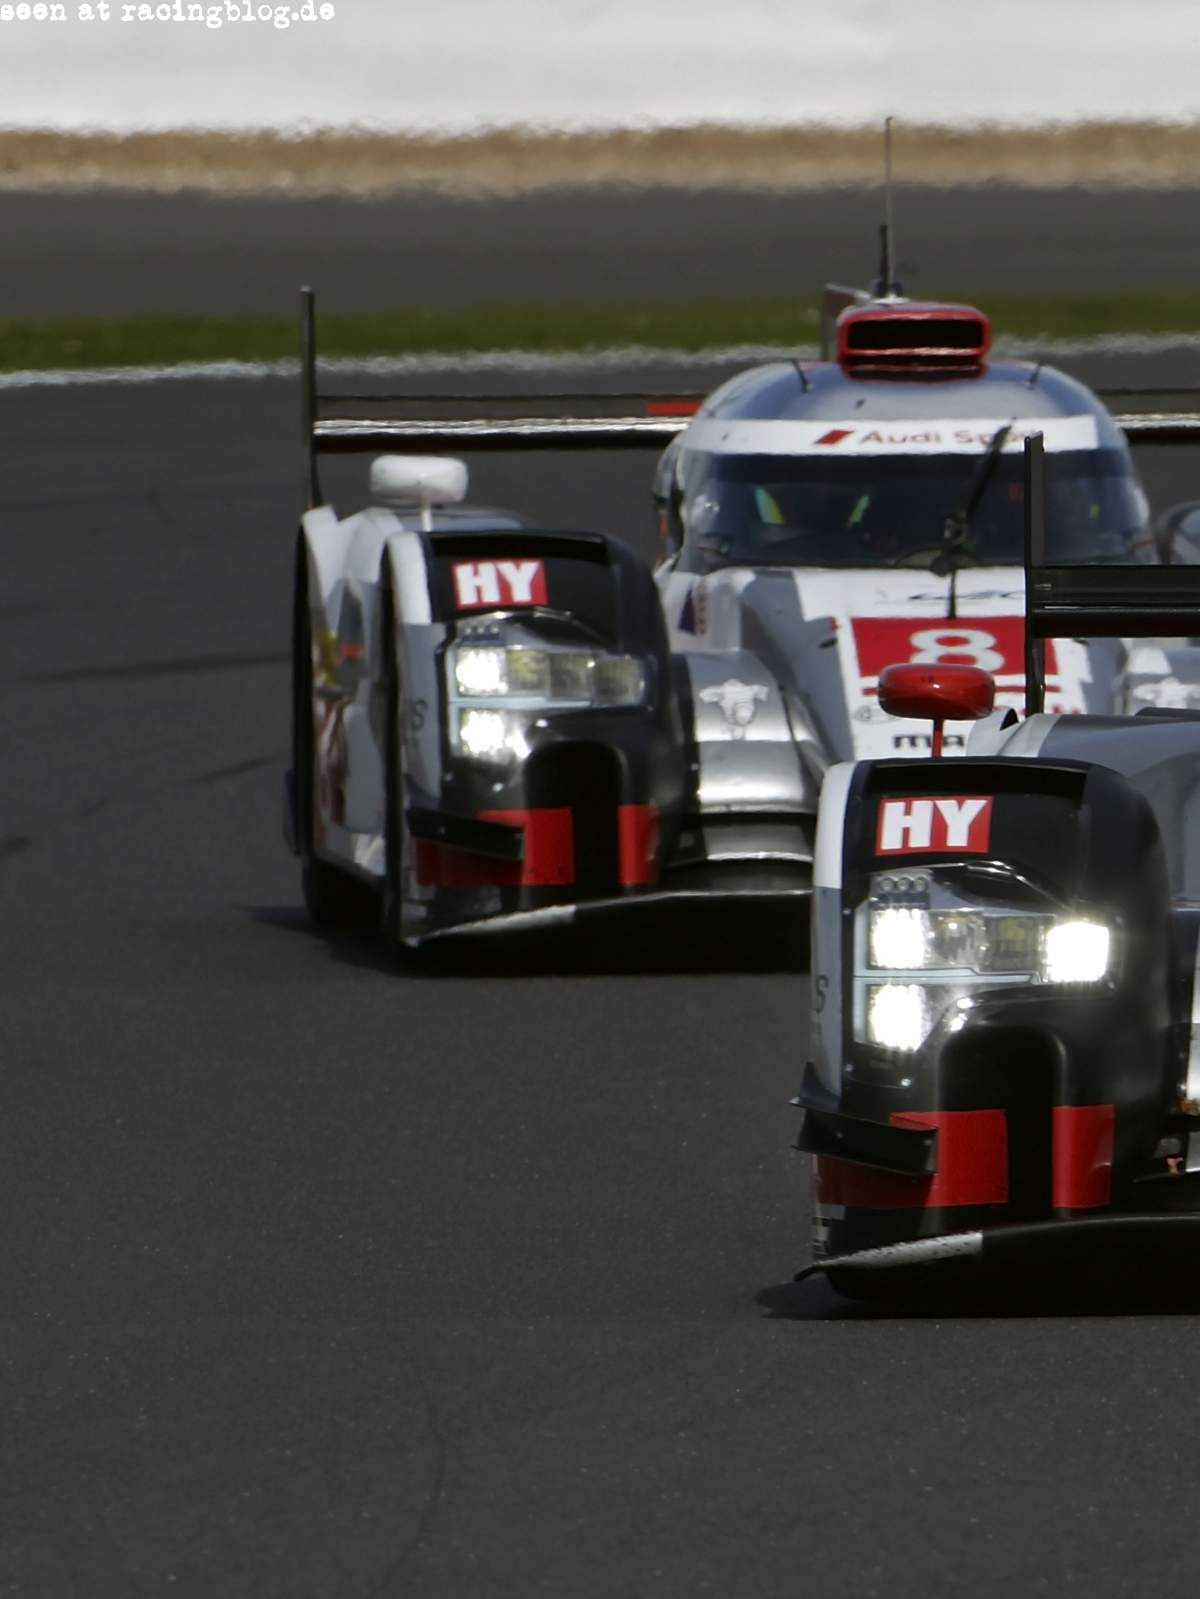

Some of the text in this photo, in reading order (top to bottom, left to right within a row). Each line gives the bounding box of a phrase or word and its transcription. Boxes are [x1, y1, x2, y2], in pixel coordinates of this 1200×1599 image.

[860, 431, 942, 444] Audi
[455, 561, 539, 605] HY
[910, 628, 1004, 674] 8
[880, 799, 988, 850] HY
